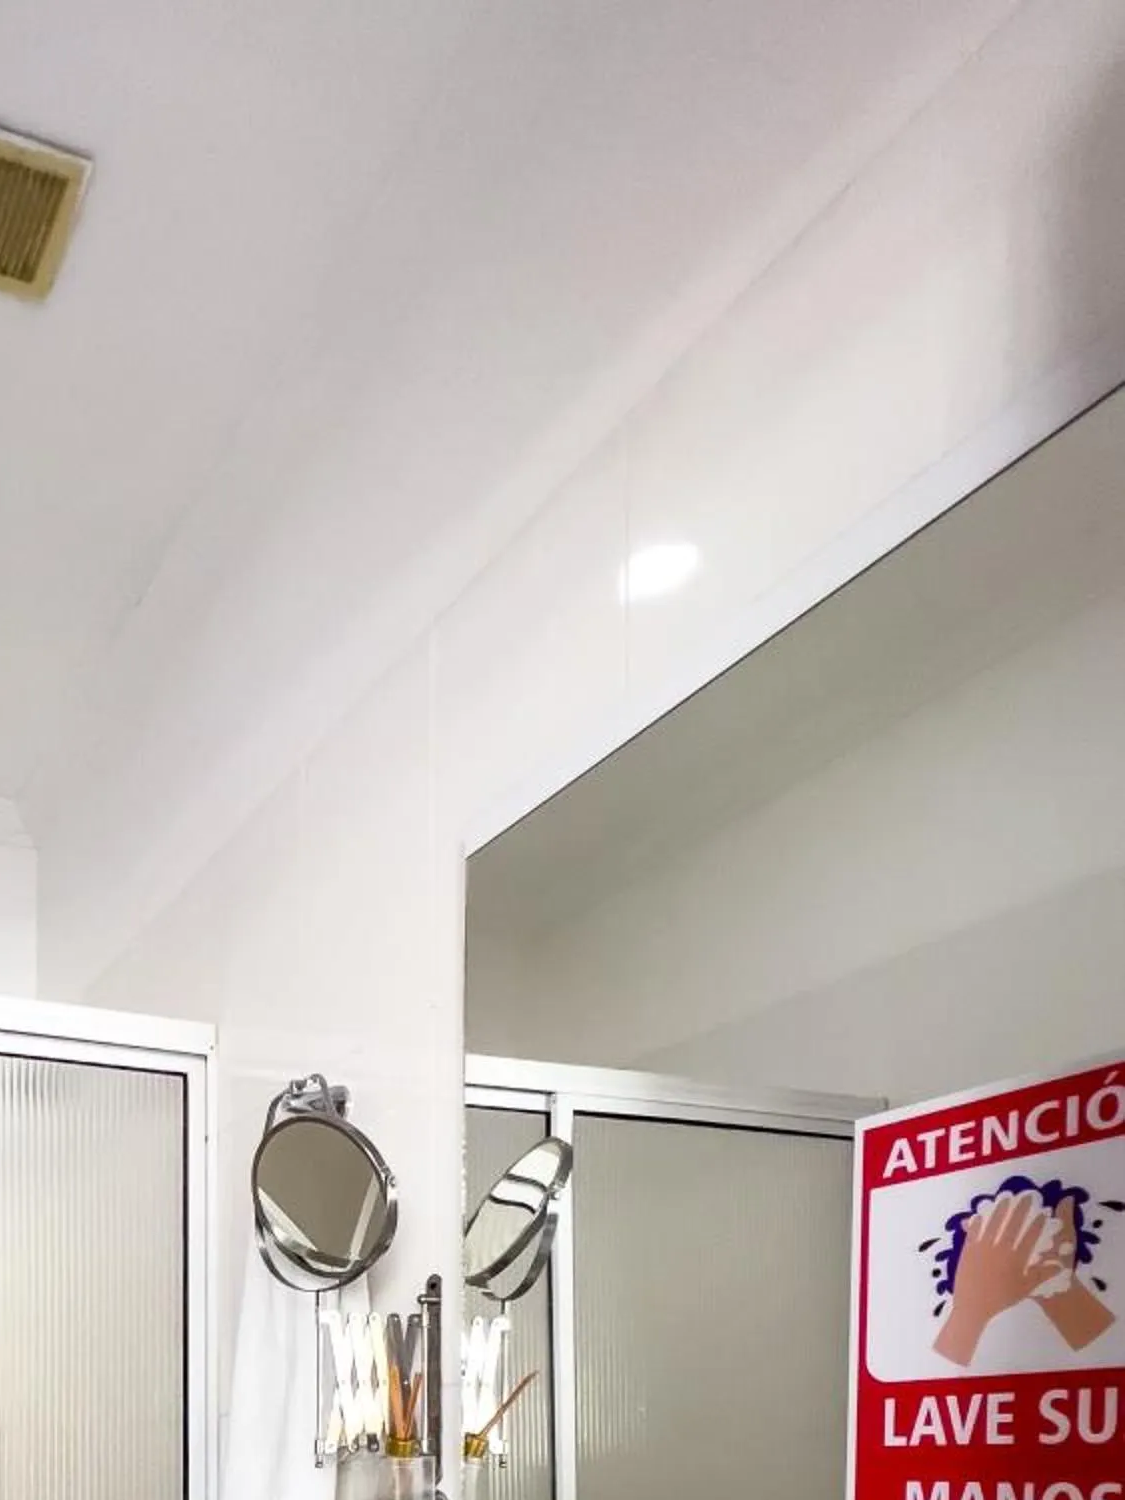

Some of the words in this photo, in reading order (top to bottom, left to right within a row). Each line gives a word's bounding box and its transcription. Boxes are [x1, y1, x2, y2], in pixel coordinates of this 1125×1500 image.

[882, 1070, 1125, 1179] ATENCIÓ
[883, 1391, 1016, 1447] LAVE
[1038, 1387, 1125, 1445] SU
